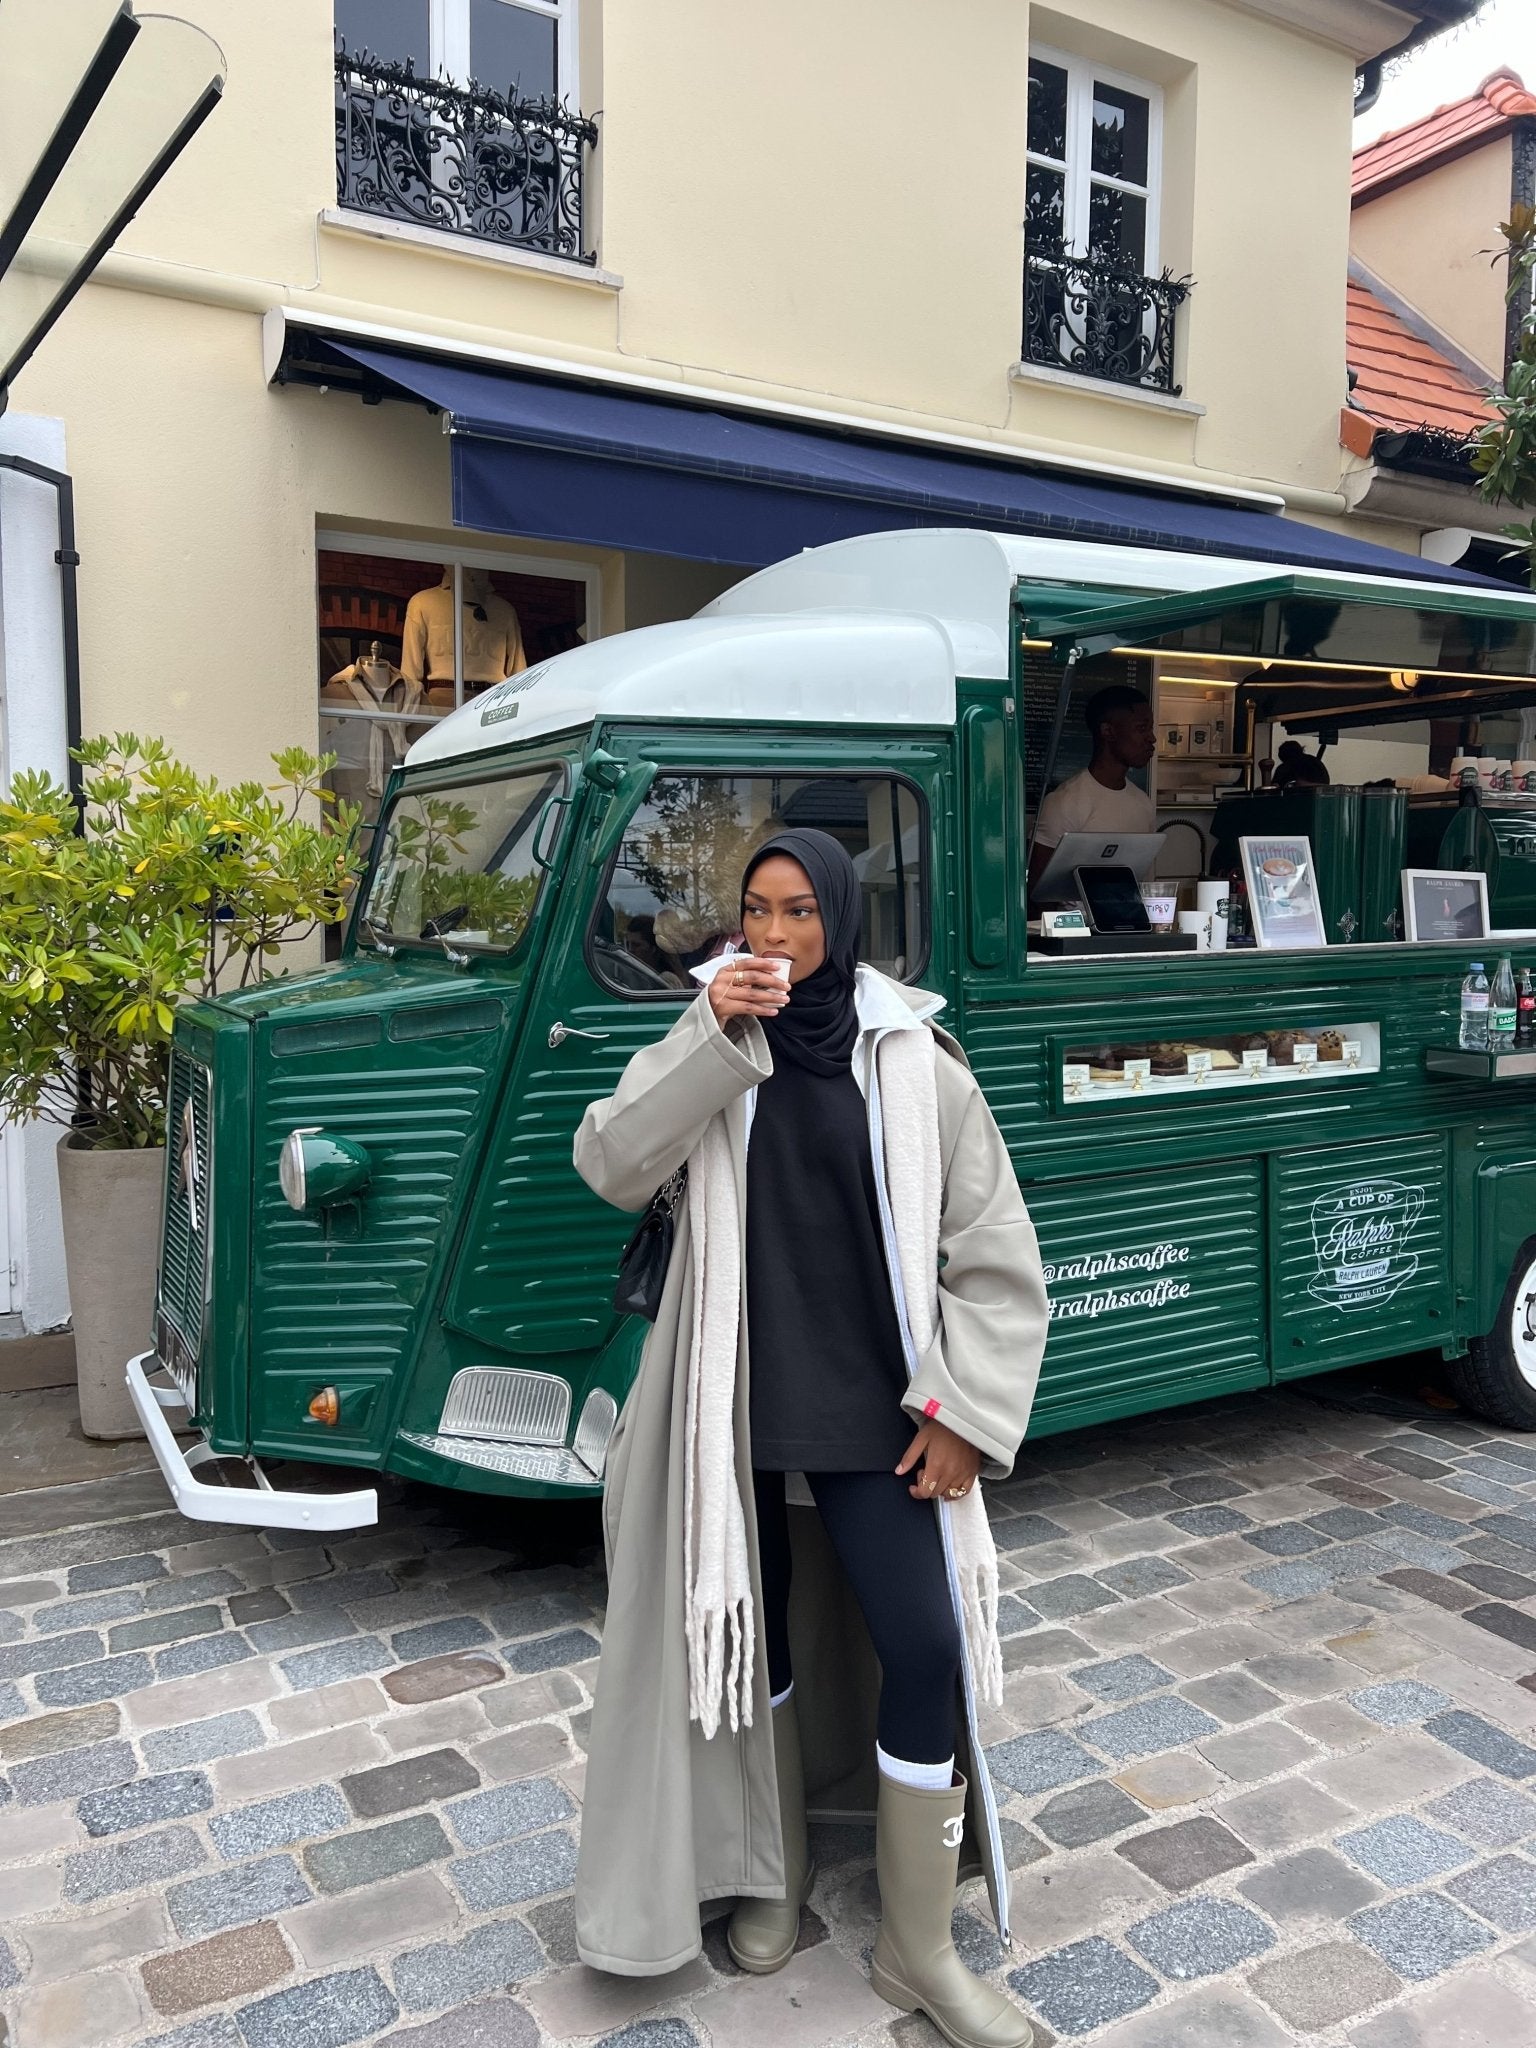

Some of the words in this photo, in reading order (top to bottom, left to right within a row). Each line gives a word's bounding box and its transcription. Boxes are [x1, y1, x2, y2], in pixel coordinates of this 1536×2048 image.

[488, 705, 515, 720] COFFEE
[1349, 1186, 1374, 1196] ENJOY
[1333, 1200, 1344, 1212] A
[1349, 1195, 1374, 1207] CUP
[1378, 1193, 1394, 1204] OF
[1322, 1216, 1394, 1266] Ralph's
[1350, 1245, 1393, 1260] COFFEE
[1042, 1243, 1190, 1285] @ralphscoffee
[1339, 1270, 1360, 1281] RALPH
[1361, 1263, 1387, 1279] LAUREN
[1047, 1279, 1191, 1319] #ralphscoffee
[1338, 1292, 1353, 1301] NEW
[1354, 1289, 1371, 1299] YORK
[1372, 1285, 1387, 1296] CITY
